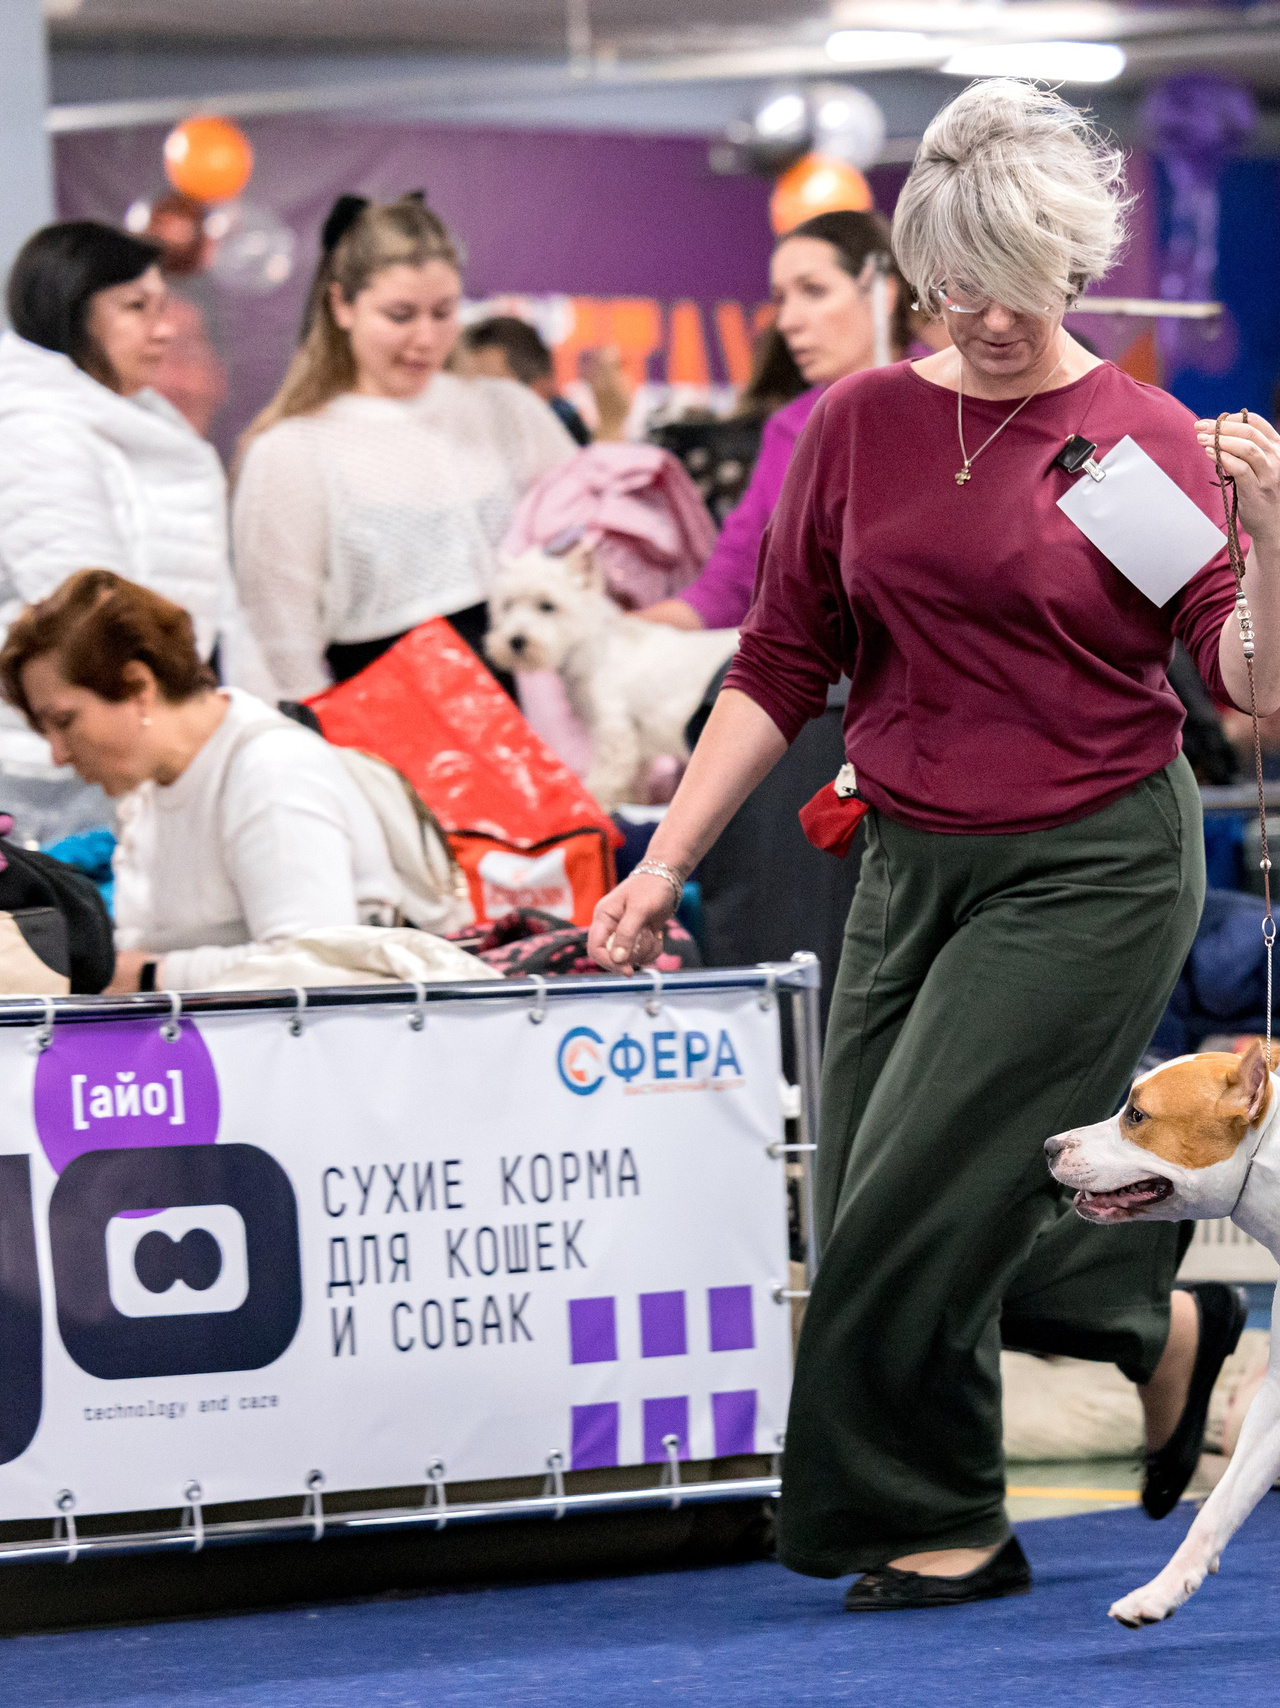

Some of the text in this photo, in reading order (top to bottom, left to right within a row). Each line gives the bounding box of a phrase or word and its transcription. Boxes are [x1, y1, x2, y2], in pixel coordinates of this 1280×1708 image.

[557, 1026, 742, 1096] СФЕРА
[322, 1147, 640, 1217] СУХИЕ КОРМА
[327, 1219, 588, 1298] ДЛЯ КОШЕК
[331, 1292, 534, 1357] И СОБАК
[83, 1394, 279, 1421] technology and care
